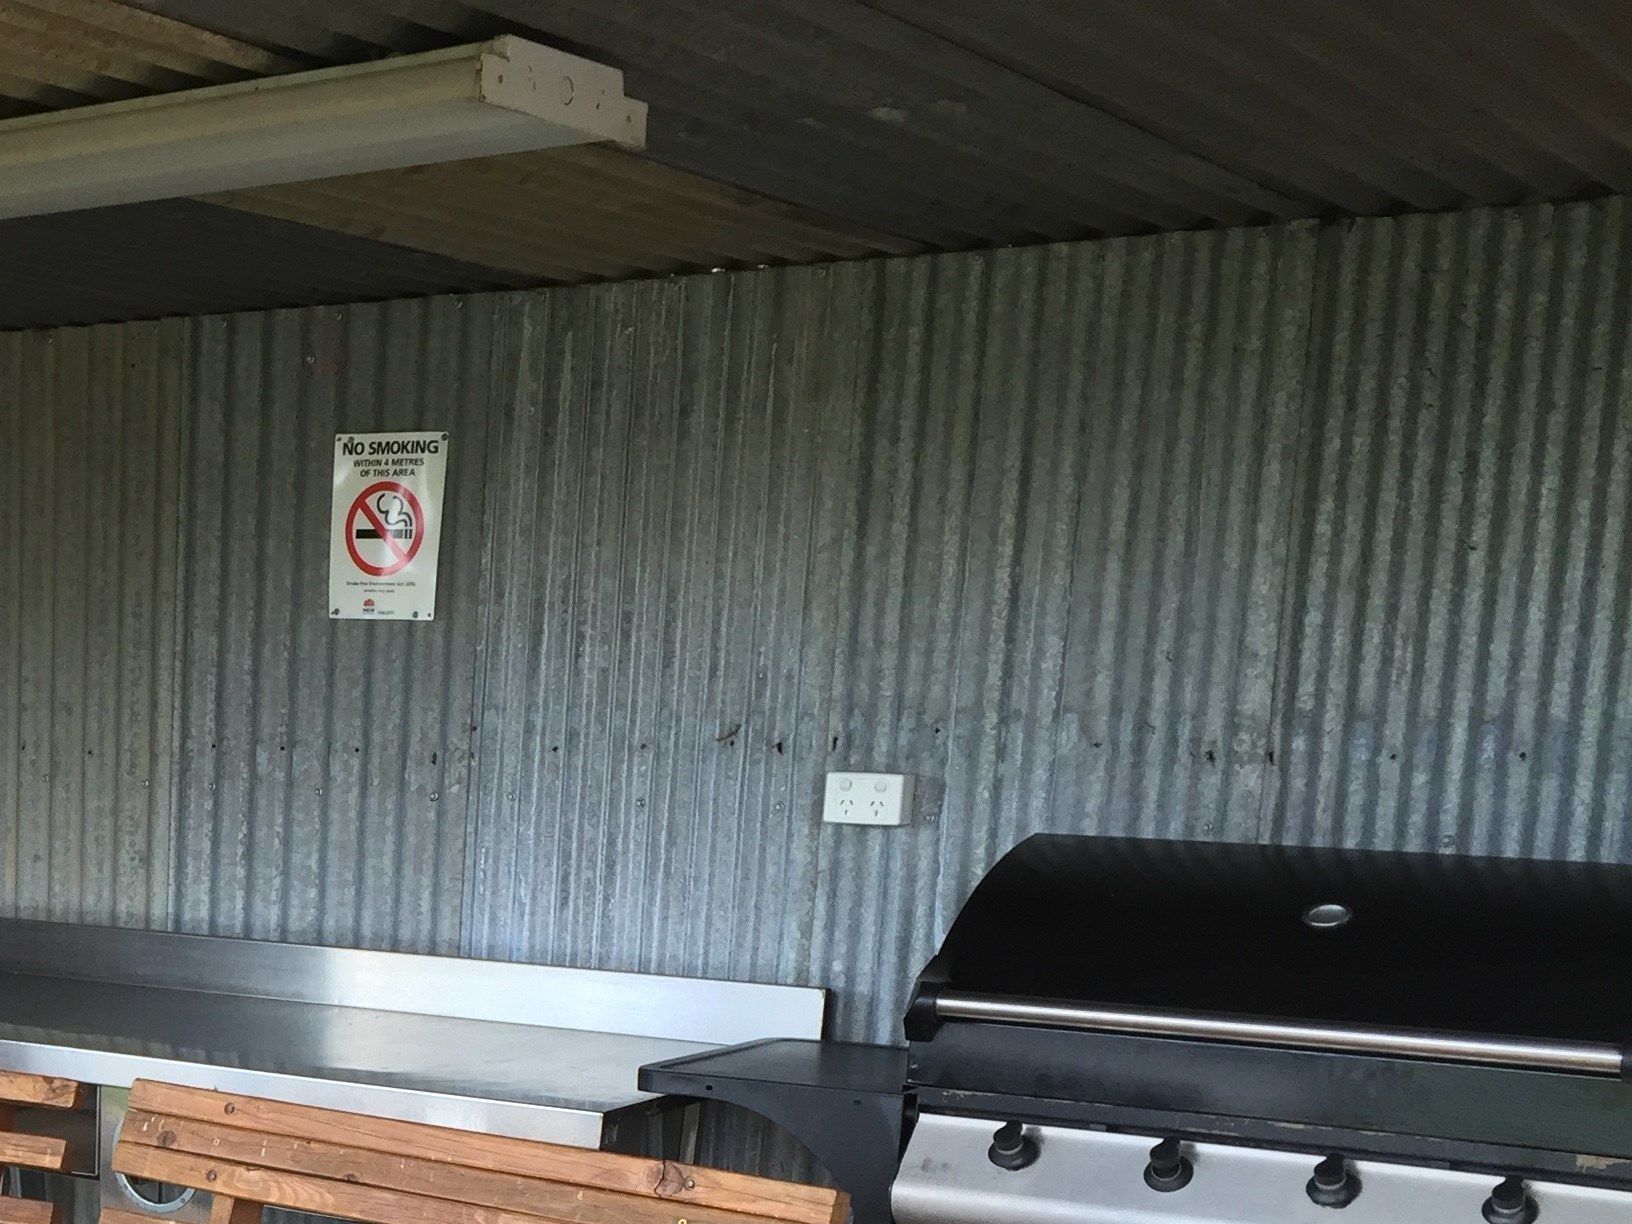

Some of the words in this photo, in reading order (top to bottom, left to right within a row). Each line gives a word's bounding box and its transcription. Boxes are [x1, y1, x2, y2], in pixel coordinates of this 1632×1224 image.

[342, 442, 365, 456] NO
[368, 440, 439, 456] SMOKING
[353, 459, 382, 467] WITHIN
[384, 459, 389, 467] 4
[391, 458, 424, 467] METRES
[360, 469, 370, 477] OF
[373, 468, 390, 477] THIS
[392, 468, 415, 477] AREA
